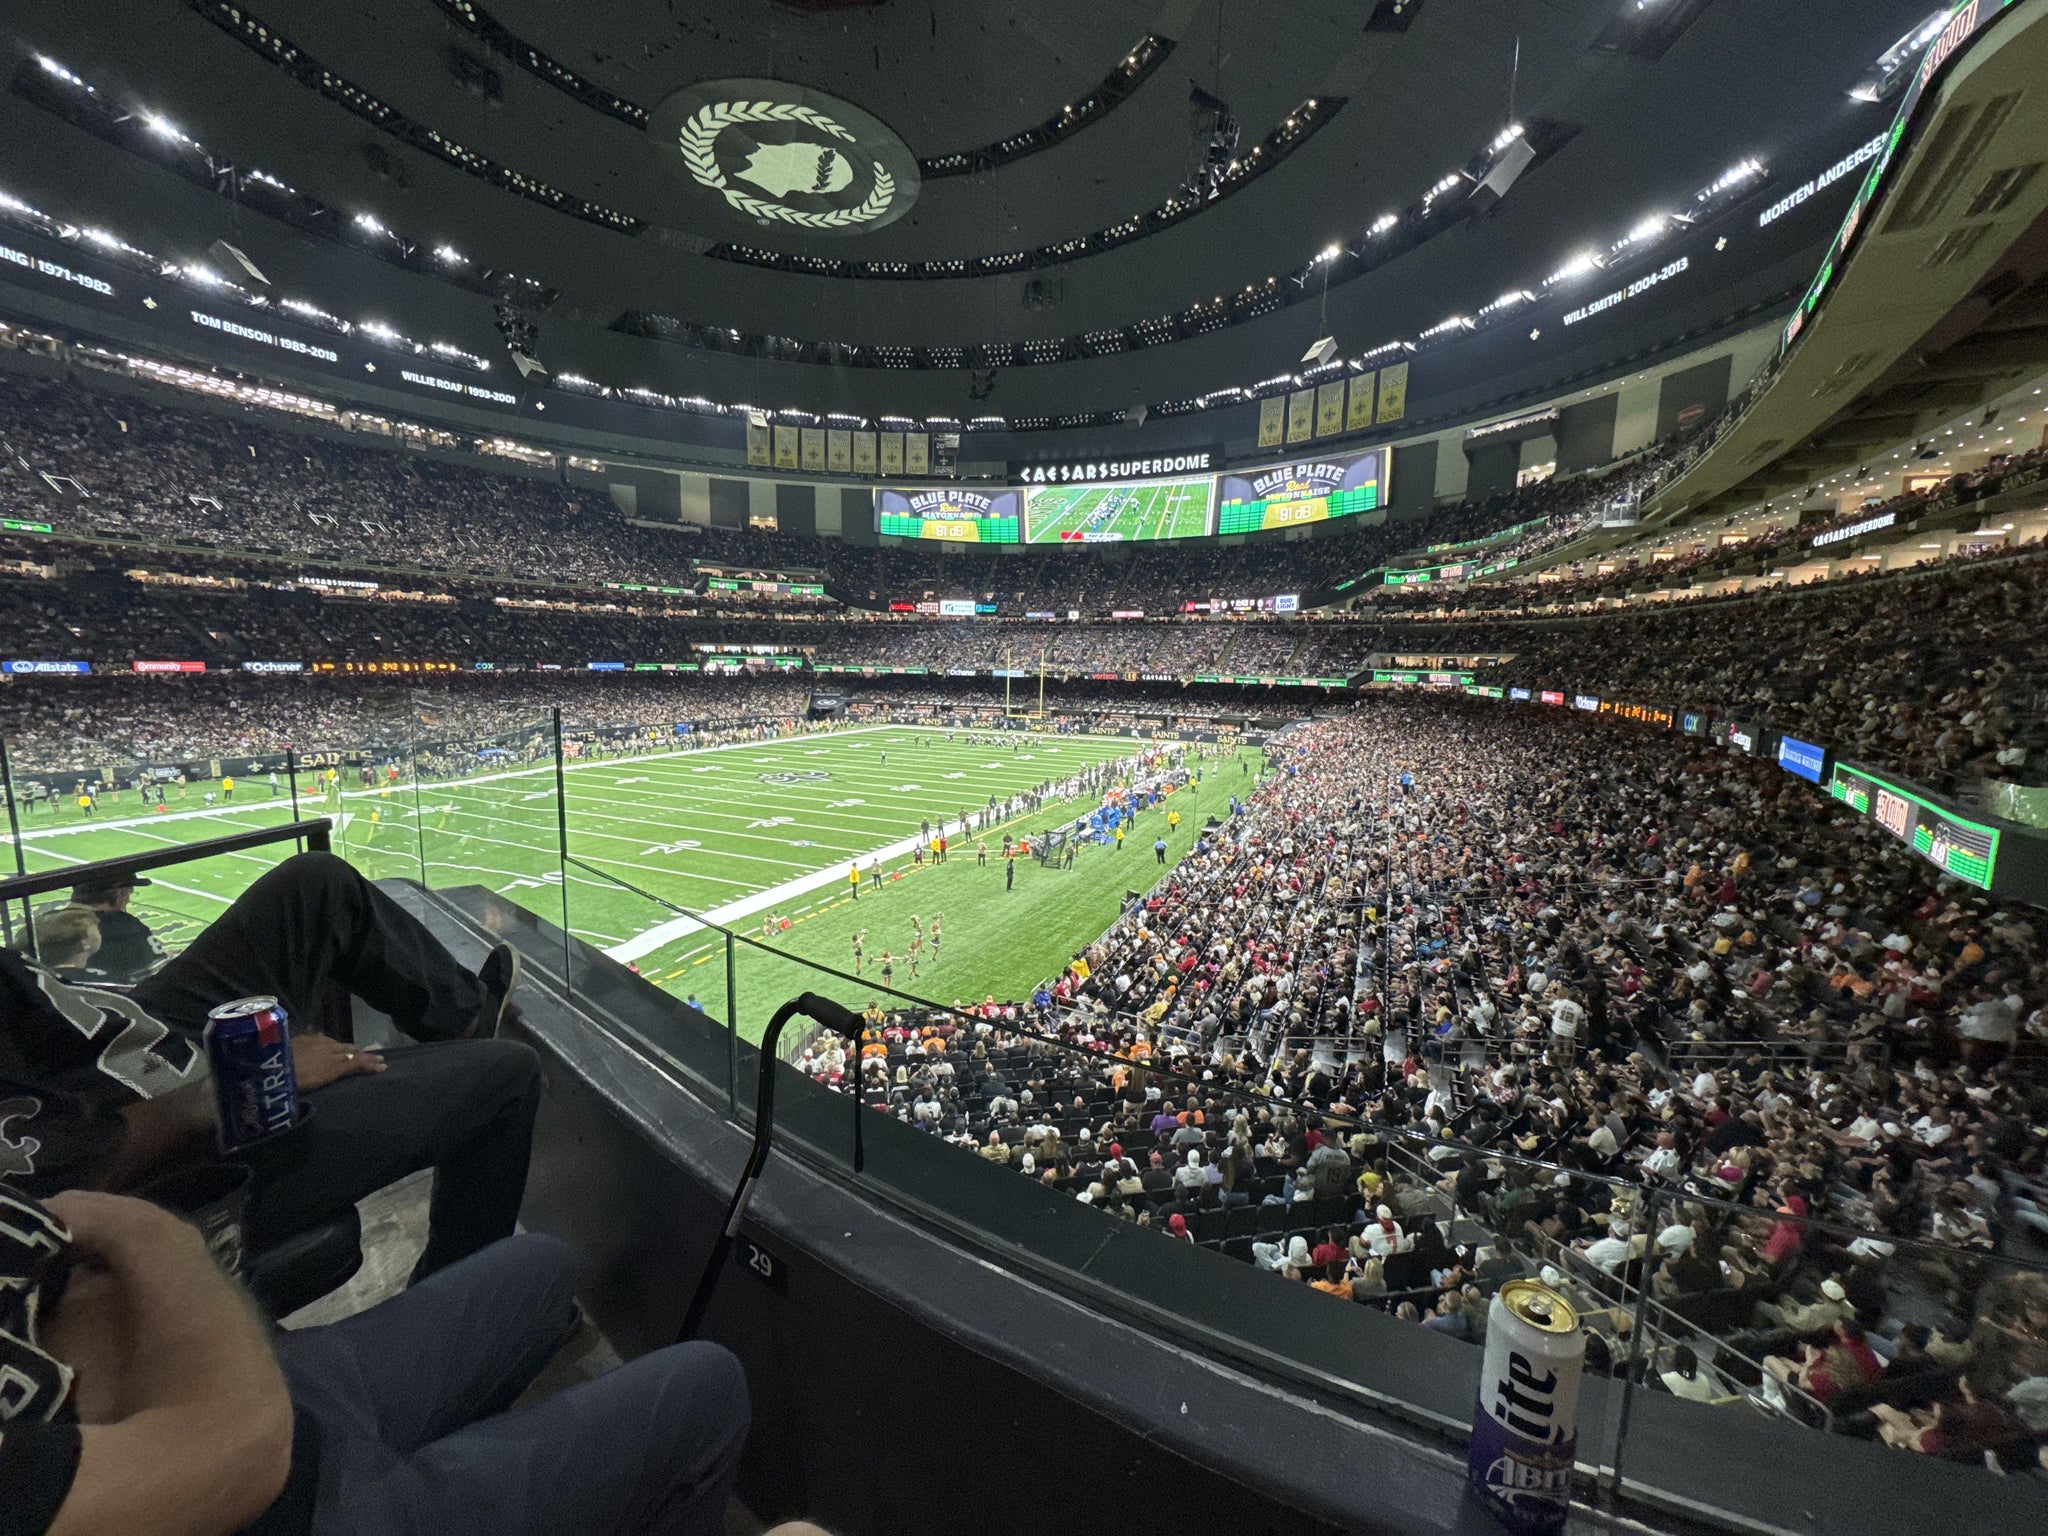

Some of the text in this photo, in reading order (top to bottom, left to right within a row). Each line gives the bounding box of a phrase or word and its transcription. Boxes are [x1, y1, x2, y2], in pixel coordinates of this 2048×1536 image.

[1759, 180, 1814, 227] MORTEN
[38, 260, 114, 296] 1971-1982
[1563, 256, 1689, 326] WILL SMITH 2004-2013
[190, 311, 338, 362] TOM BENSON 1985-2018
[401, 370, 516, 405] WILLIE ROAF 1993-2001
[1021, 454, 1210, 482] CAESARS SUPERDOME
[1253, 464, 1344, 493] BLUE PLATE
[1285, 478, 1311, 492] Real
[910, 491, 993, 510] BLUE PLATE
[940, 502, 962, 513] Real
[1295, 505, 1311, 520] dB
[950, 525, 964, 537] dB
[1812, 513, 1896, 547] CAESARS SUPERDOME
[298, 577, 343, 586] CAESARS
[34, 661, 78, 672] Allstate
[138, 661, 181, 672] Community
[253, 661, 302, 672] Ochsner
[950, 669, 976, 677] Ochsner
[1089, 727, 1116, 735] SAINTS
[1151, 731, 1179, 739] SAINTS
[640, 840, 702, 856] 20
[749, 1244, 772, 1277] 29
